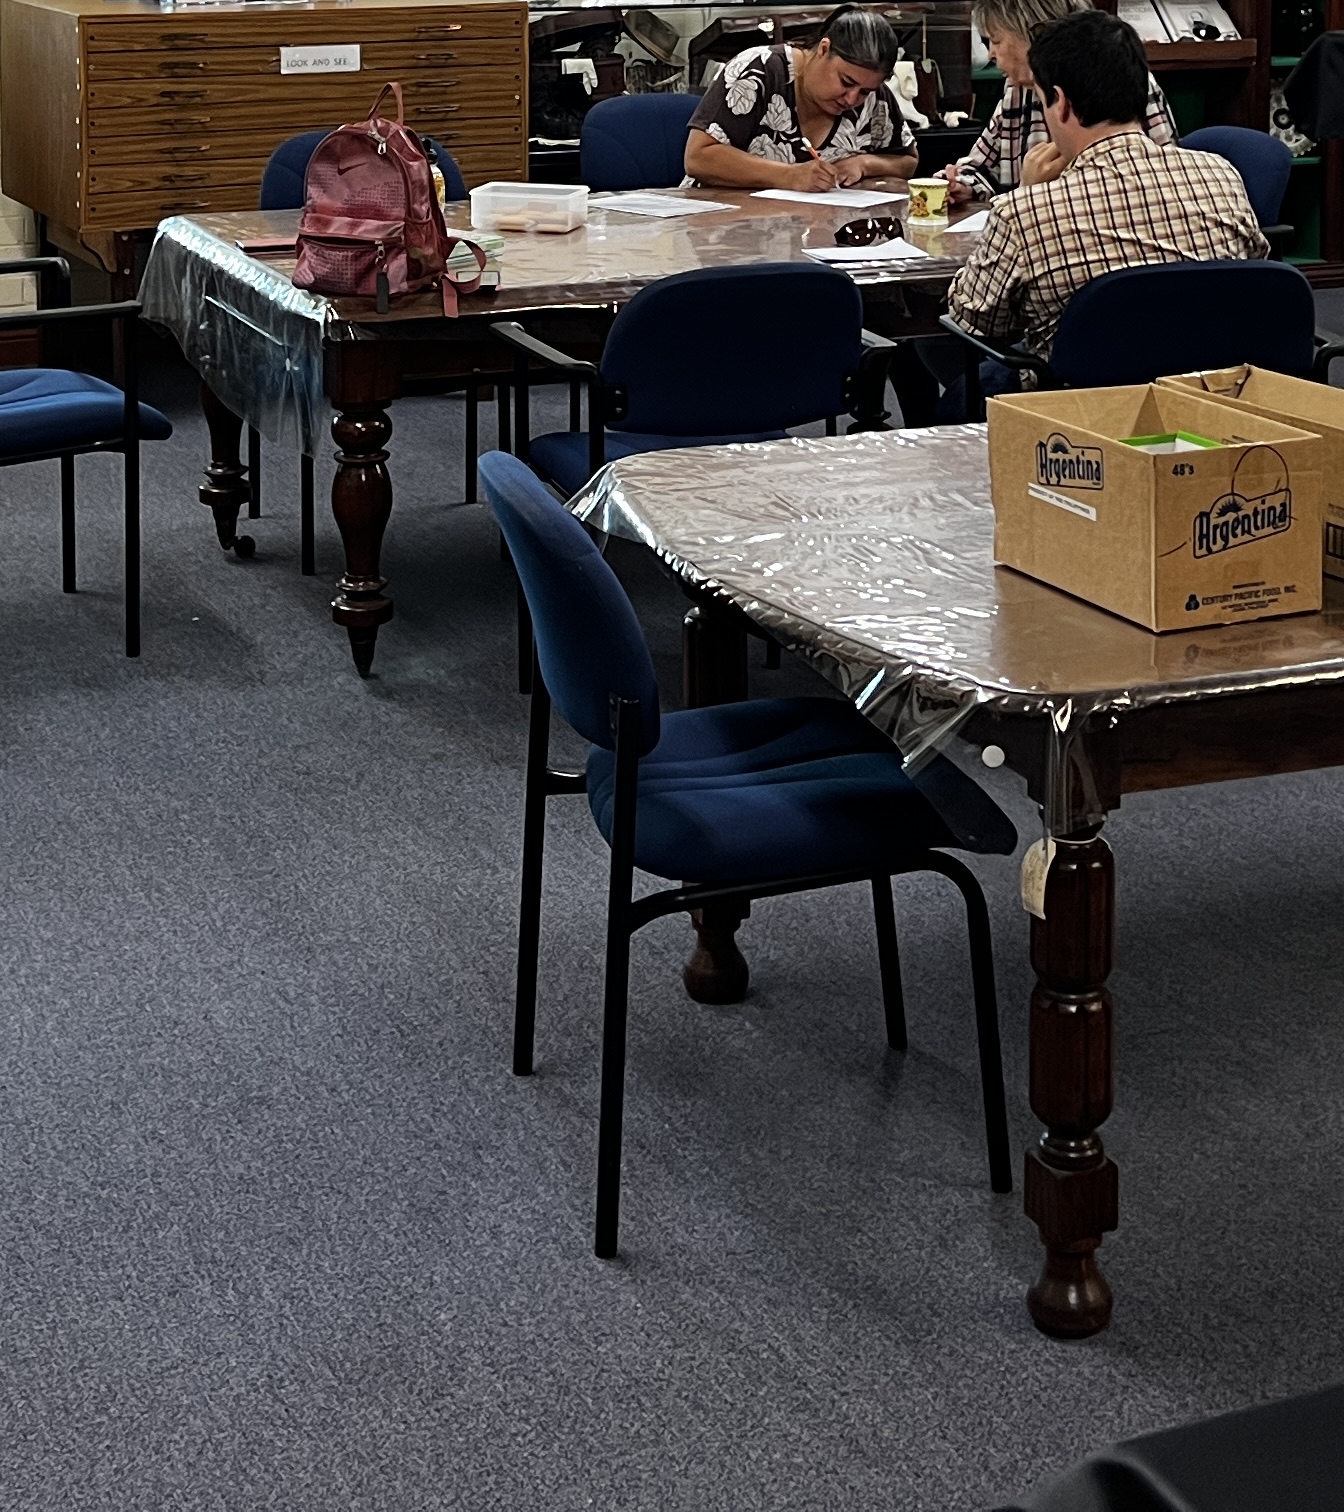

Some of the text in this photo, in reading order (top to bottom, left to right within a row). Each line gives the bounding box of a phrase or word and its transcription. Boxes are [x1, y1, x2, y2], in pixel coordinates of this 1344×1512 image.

[286, 57, 347, 68] LOOK AND SEE
[1039, 440, 1101, 485] Argentina
[1198, 498, 1287, 555] Argentina
[1201, 594, 1233, 606] CENTURY
[1234, 590, 1261, 601] PACIFIC
